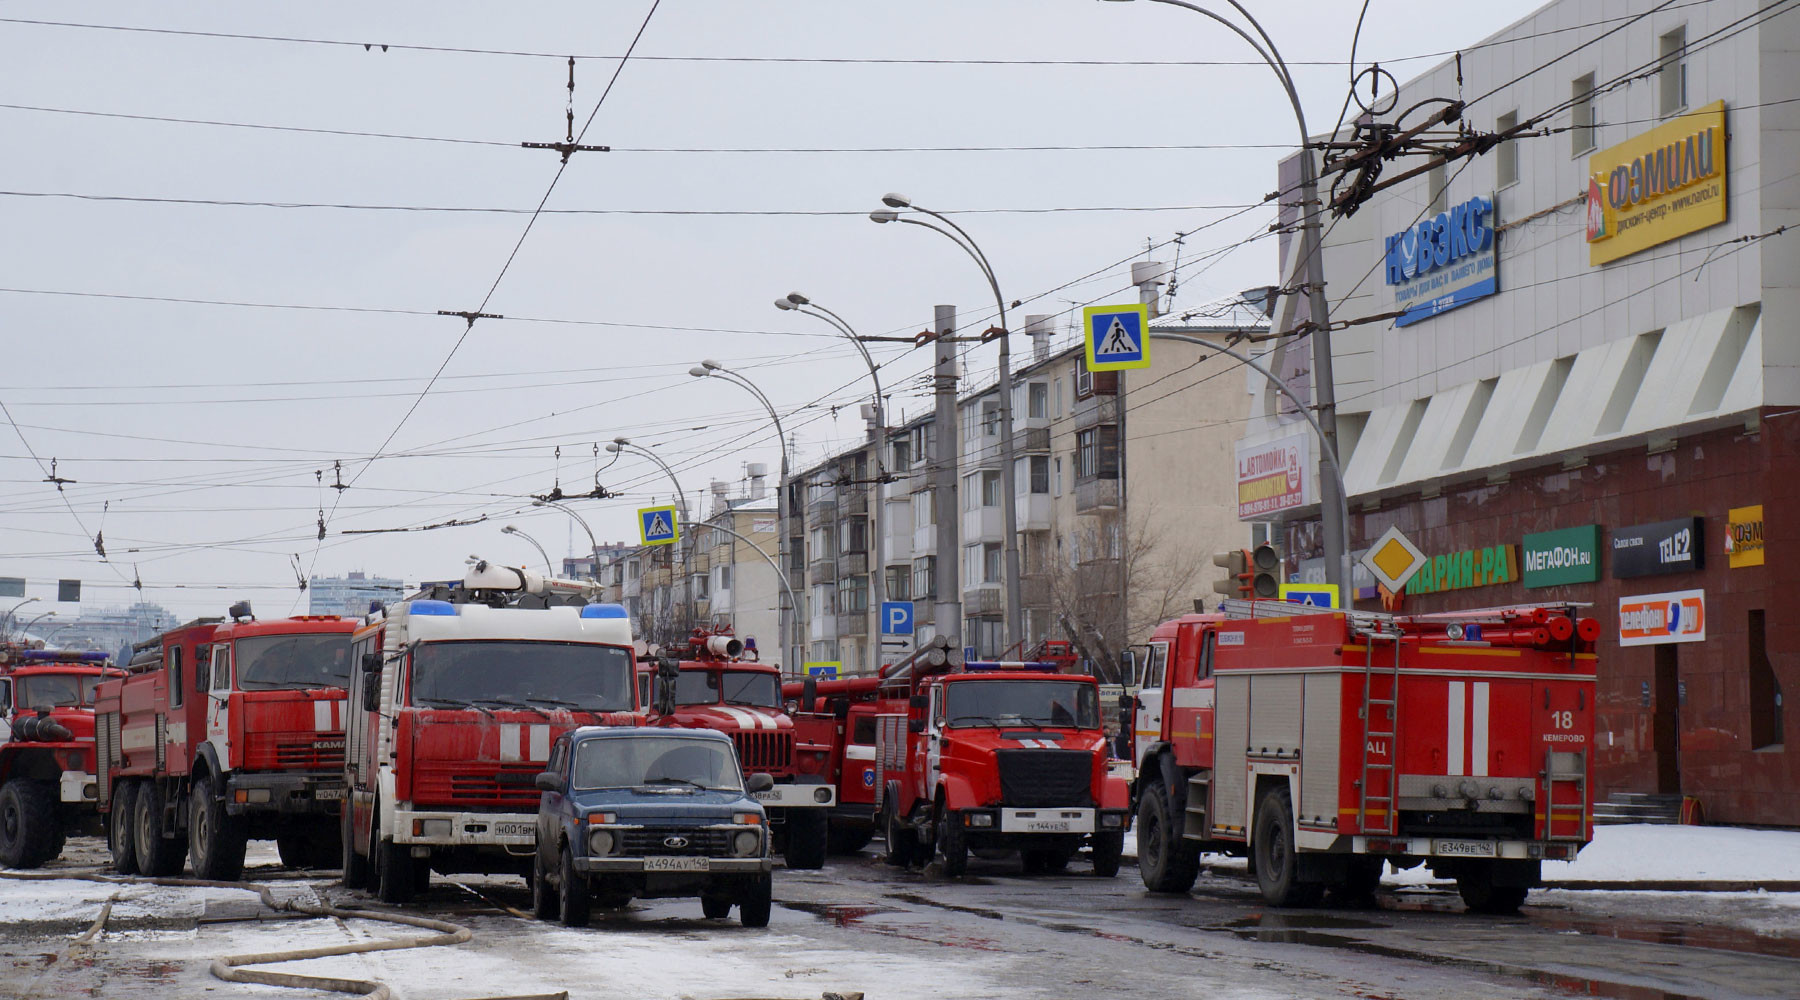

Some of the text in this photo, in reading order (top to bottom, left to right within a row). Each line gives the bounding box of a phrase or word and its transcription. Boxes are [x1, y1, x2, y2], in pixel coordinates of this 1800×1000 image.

[1246, 447, 1287, 476] АВТОМОЙКА
[1659, 527, 1691, 564] TELE2
[889, 607, 908, 634] P
[1551, 711, 1573, 729] 18
[1542, 734, 1585, 743] КЕМЕРОВО
